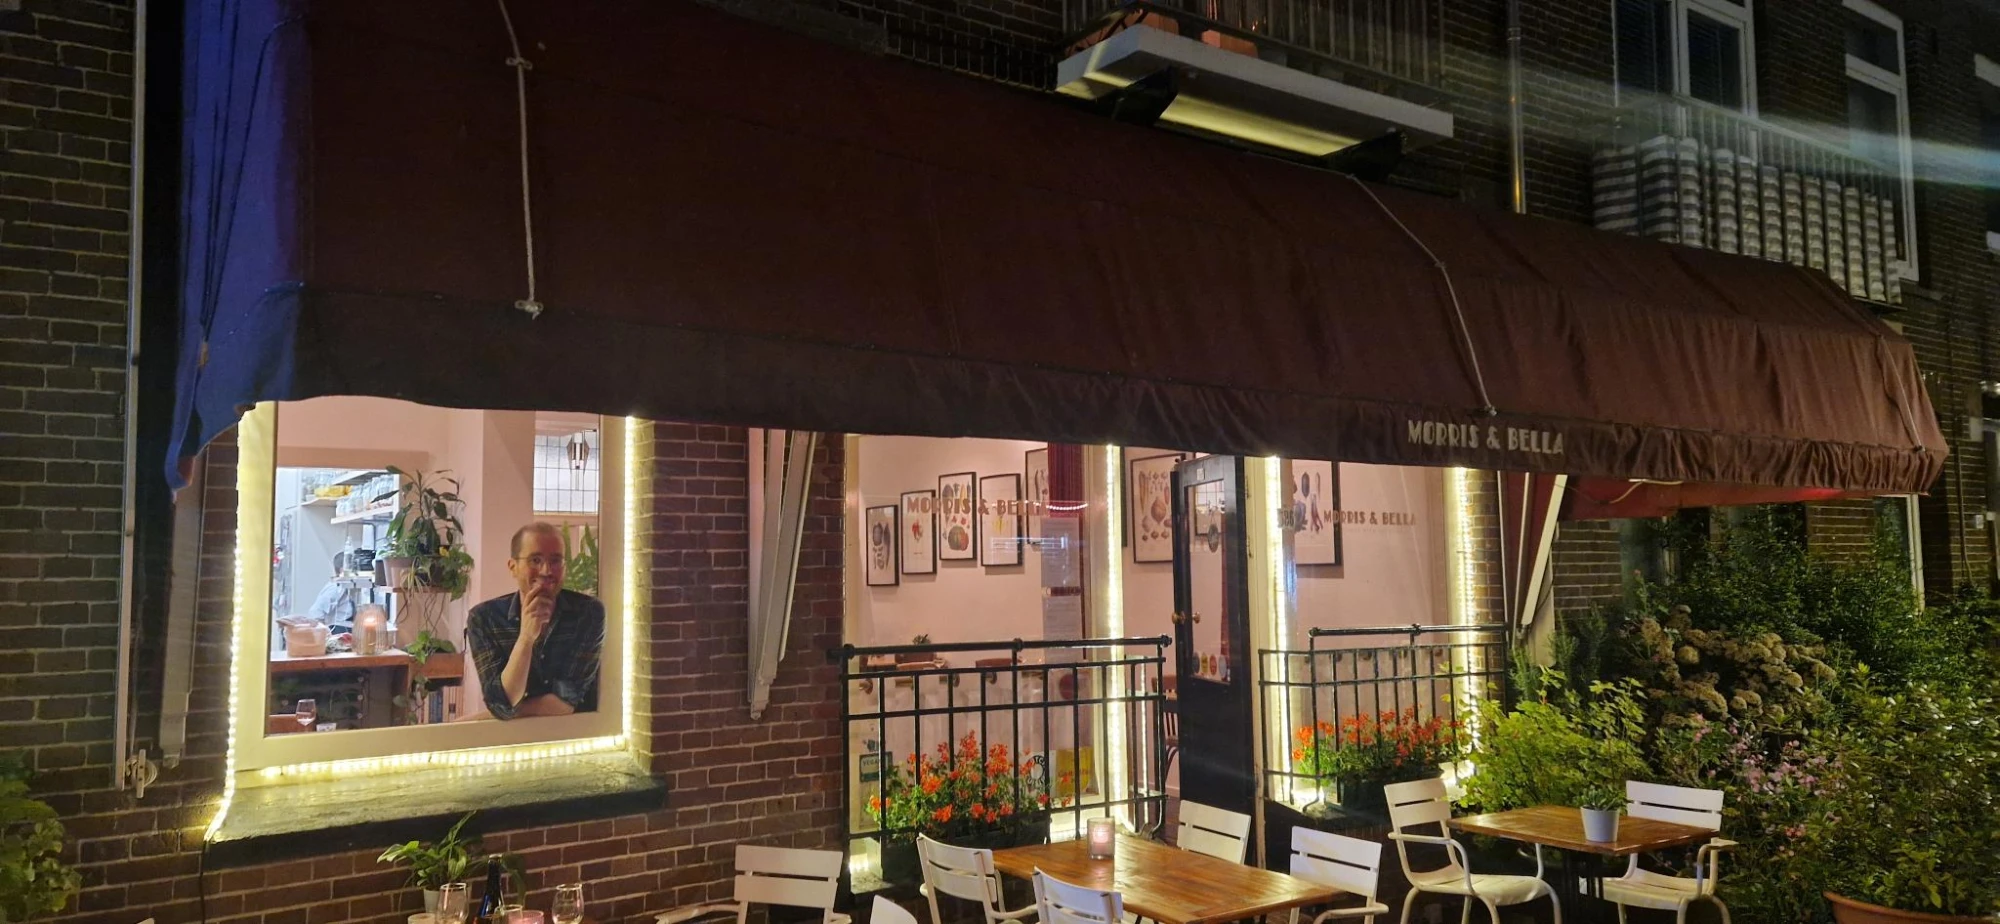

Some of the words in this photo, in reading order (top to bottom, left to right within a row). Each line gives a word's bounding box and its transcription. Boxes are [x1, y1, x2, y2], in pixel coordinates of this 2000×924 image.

[1407, 419, 1480, 449] MORRIS
[1486, 425, 1501, 450] &
[1507, 427, 1565, 455] BELLA
[907, 496, 971, 514] MORRIS
[978, 498, 990, 515] &
[1323, 509, 1366, 525] MORRIS
[1369, 511, 1378, 525] &
[1382, 511, 1416, 526] BELLA
